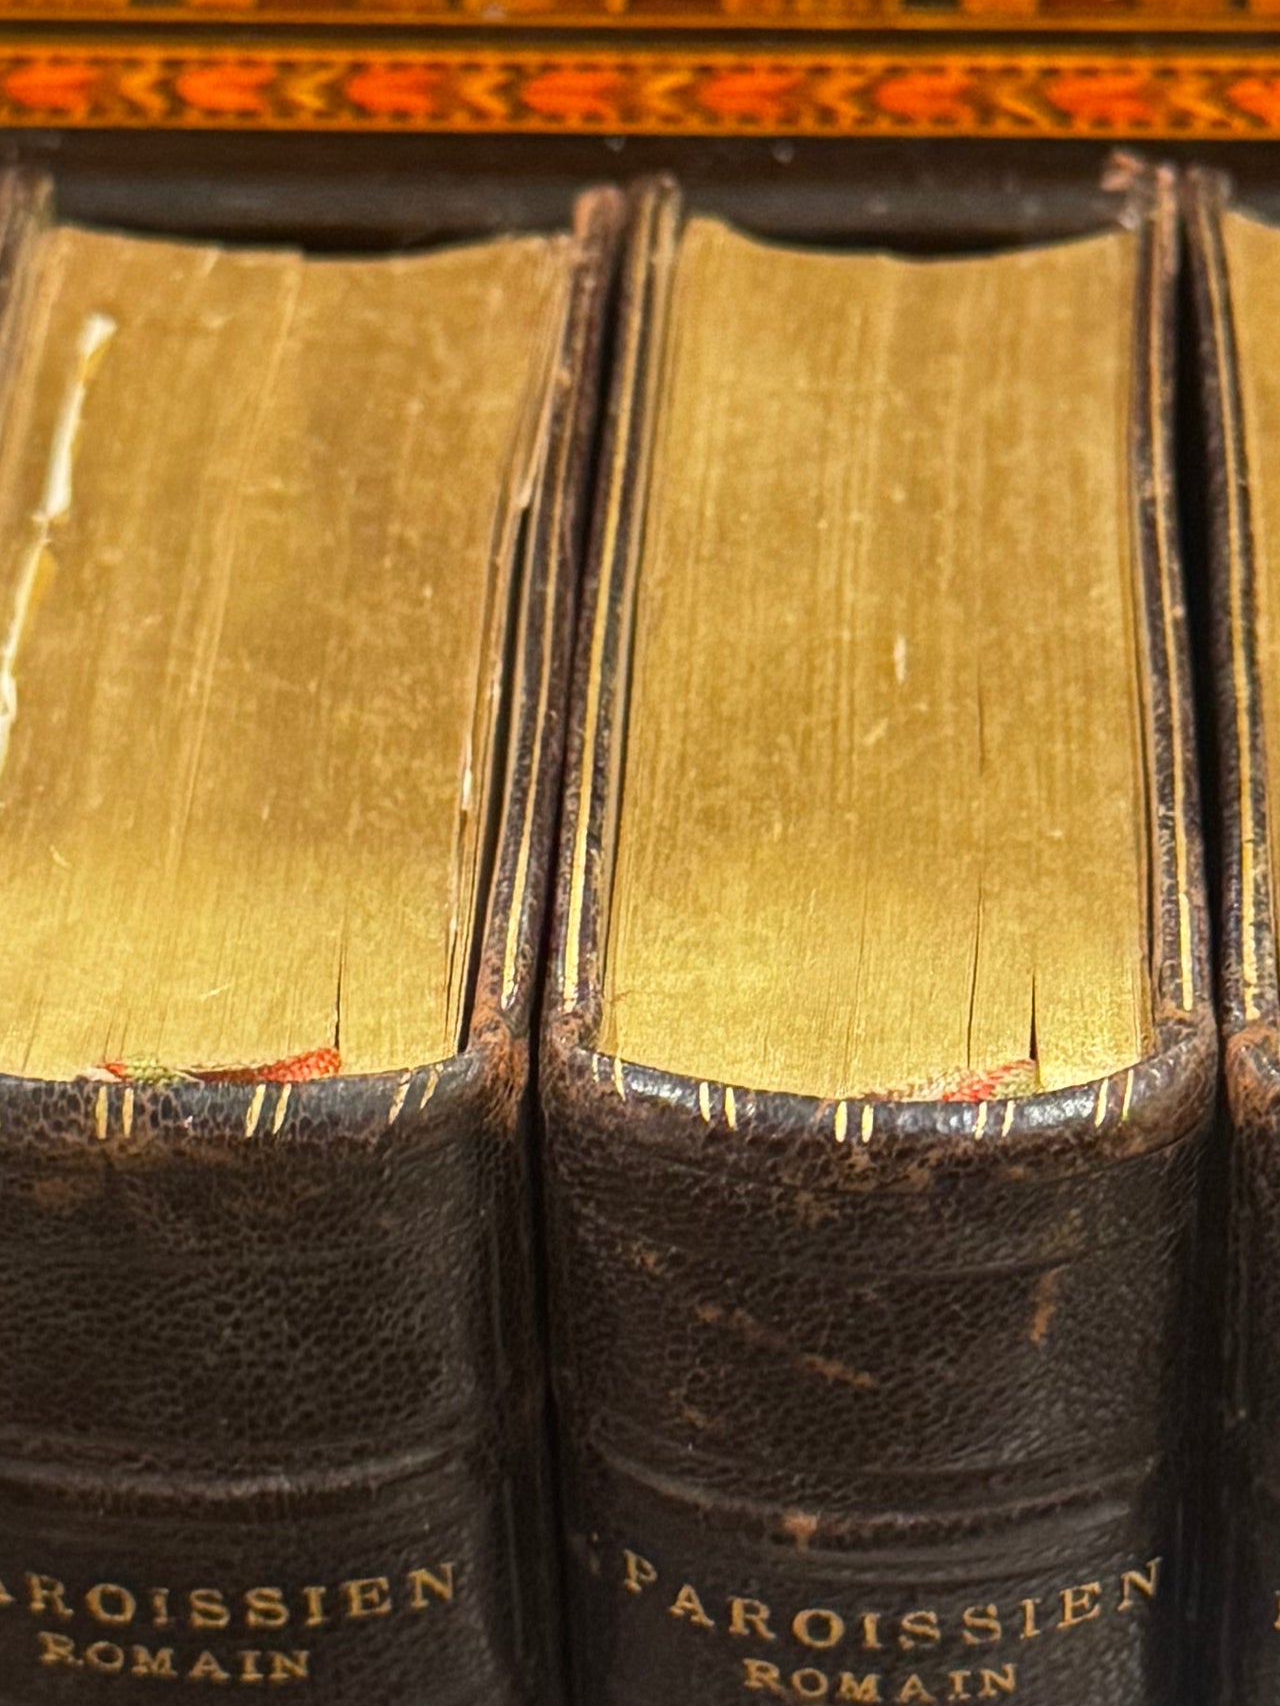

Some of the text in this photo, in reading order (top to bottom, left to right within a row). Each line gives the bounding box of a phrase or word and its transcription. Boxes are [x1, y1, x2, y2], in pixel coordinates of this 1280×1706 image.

[623, 1549, 1162, 1649] PAROISSIEN
[37, 1631, 310, 1682] ROMAIN
[743, 1657, 1018, 1704] ROMAIN
